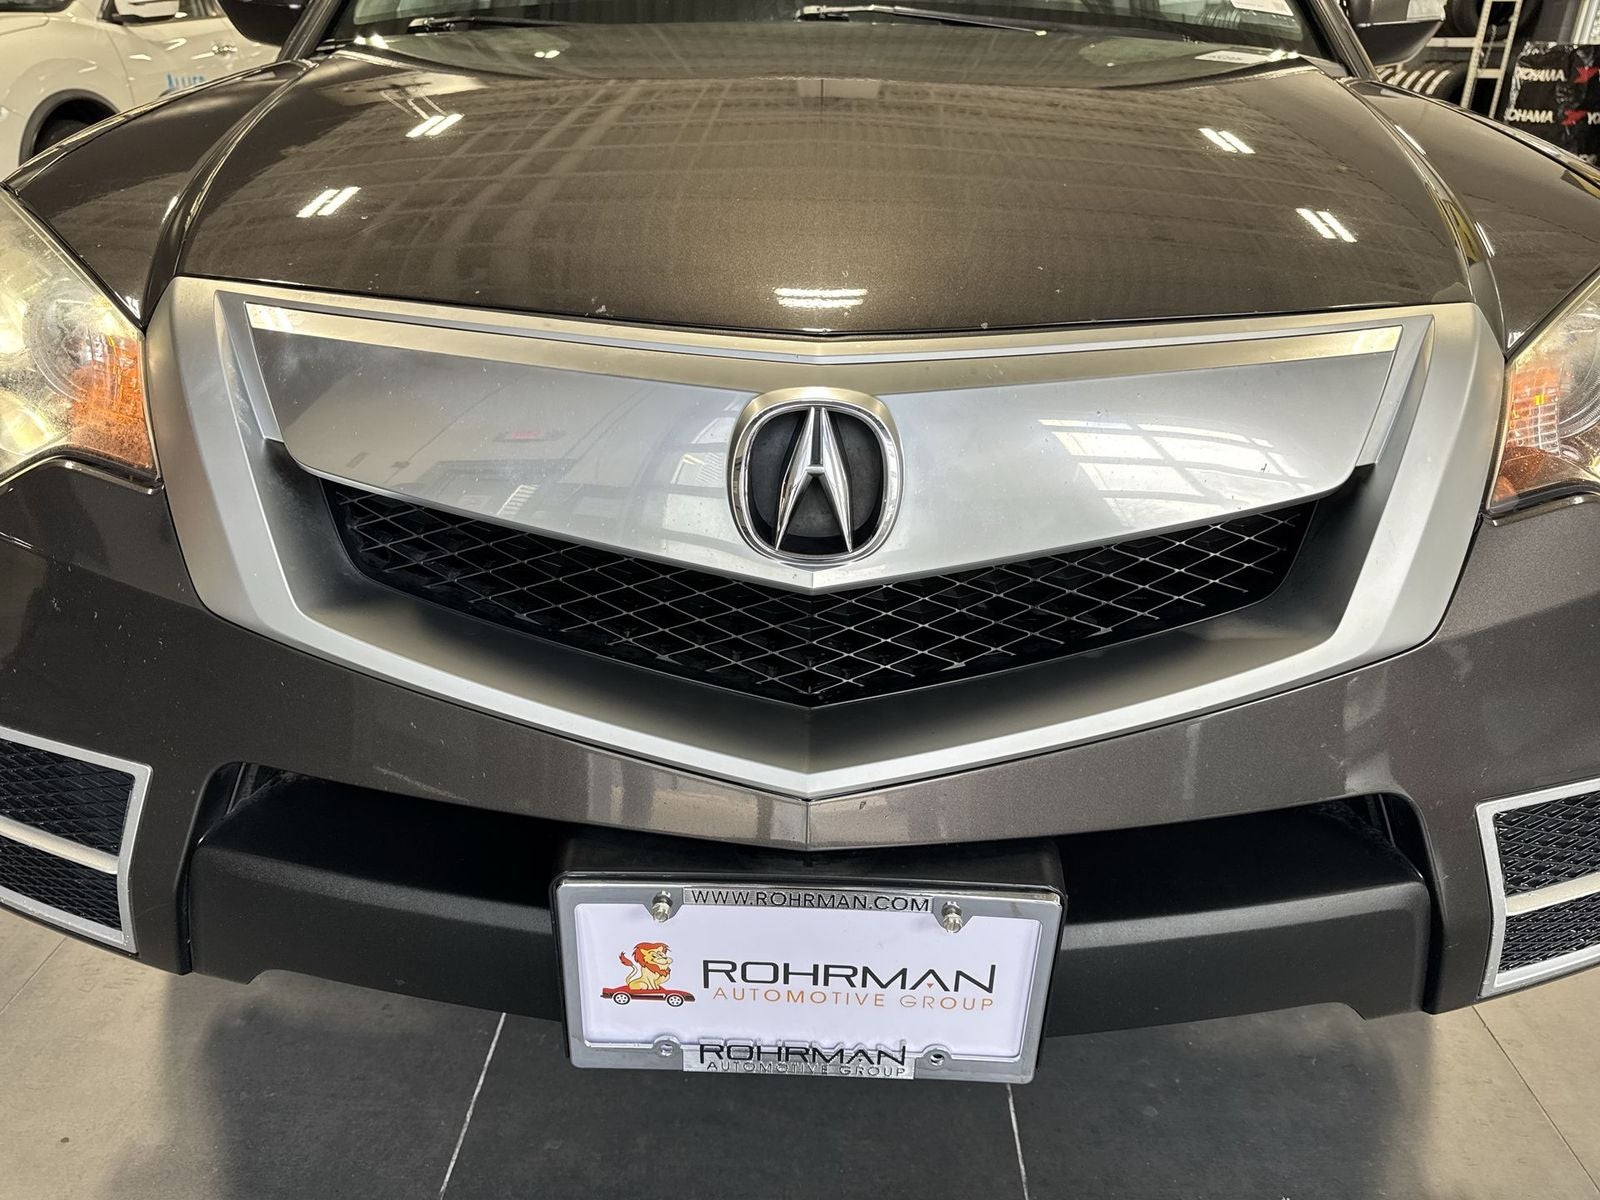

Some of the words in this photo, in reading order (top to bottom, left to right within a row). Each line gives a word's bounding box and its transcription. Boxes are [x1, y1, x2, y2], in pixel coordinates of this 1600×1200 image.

[691, 890, 929, 912] WWW.ROHRMAN.COM
[702, 959, 996, 994] ROHRMAN
[712, 986, 885, 1007] AUTOMOTIVE
[899, 994, 994, 1012] GROUP
[699, 1043, 906, 1067] ROHRMAN
[706, 1060, 829, 1076] AUTOMOTIVE
[838, 1065, 907, 1078] GROUP
